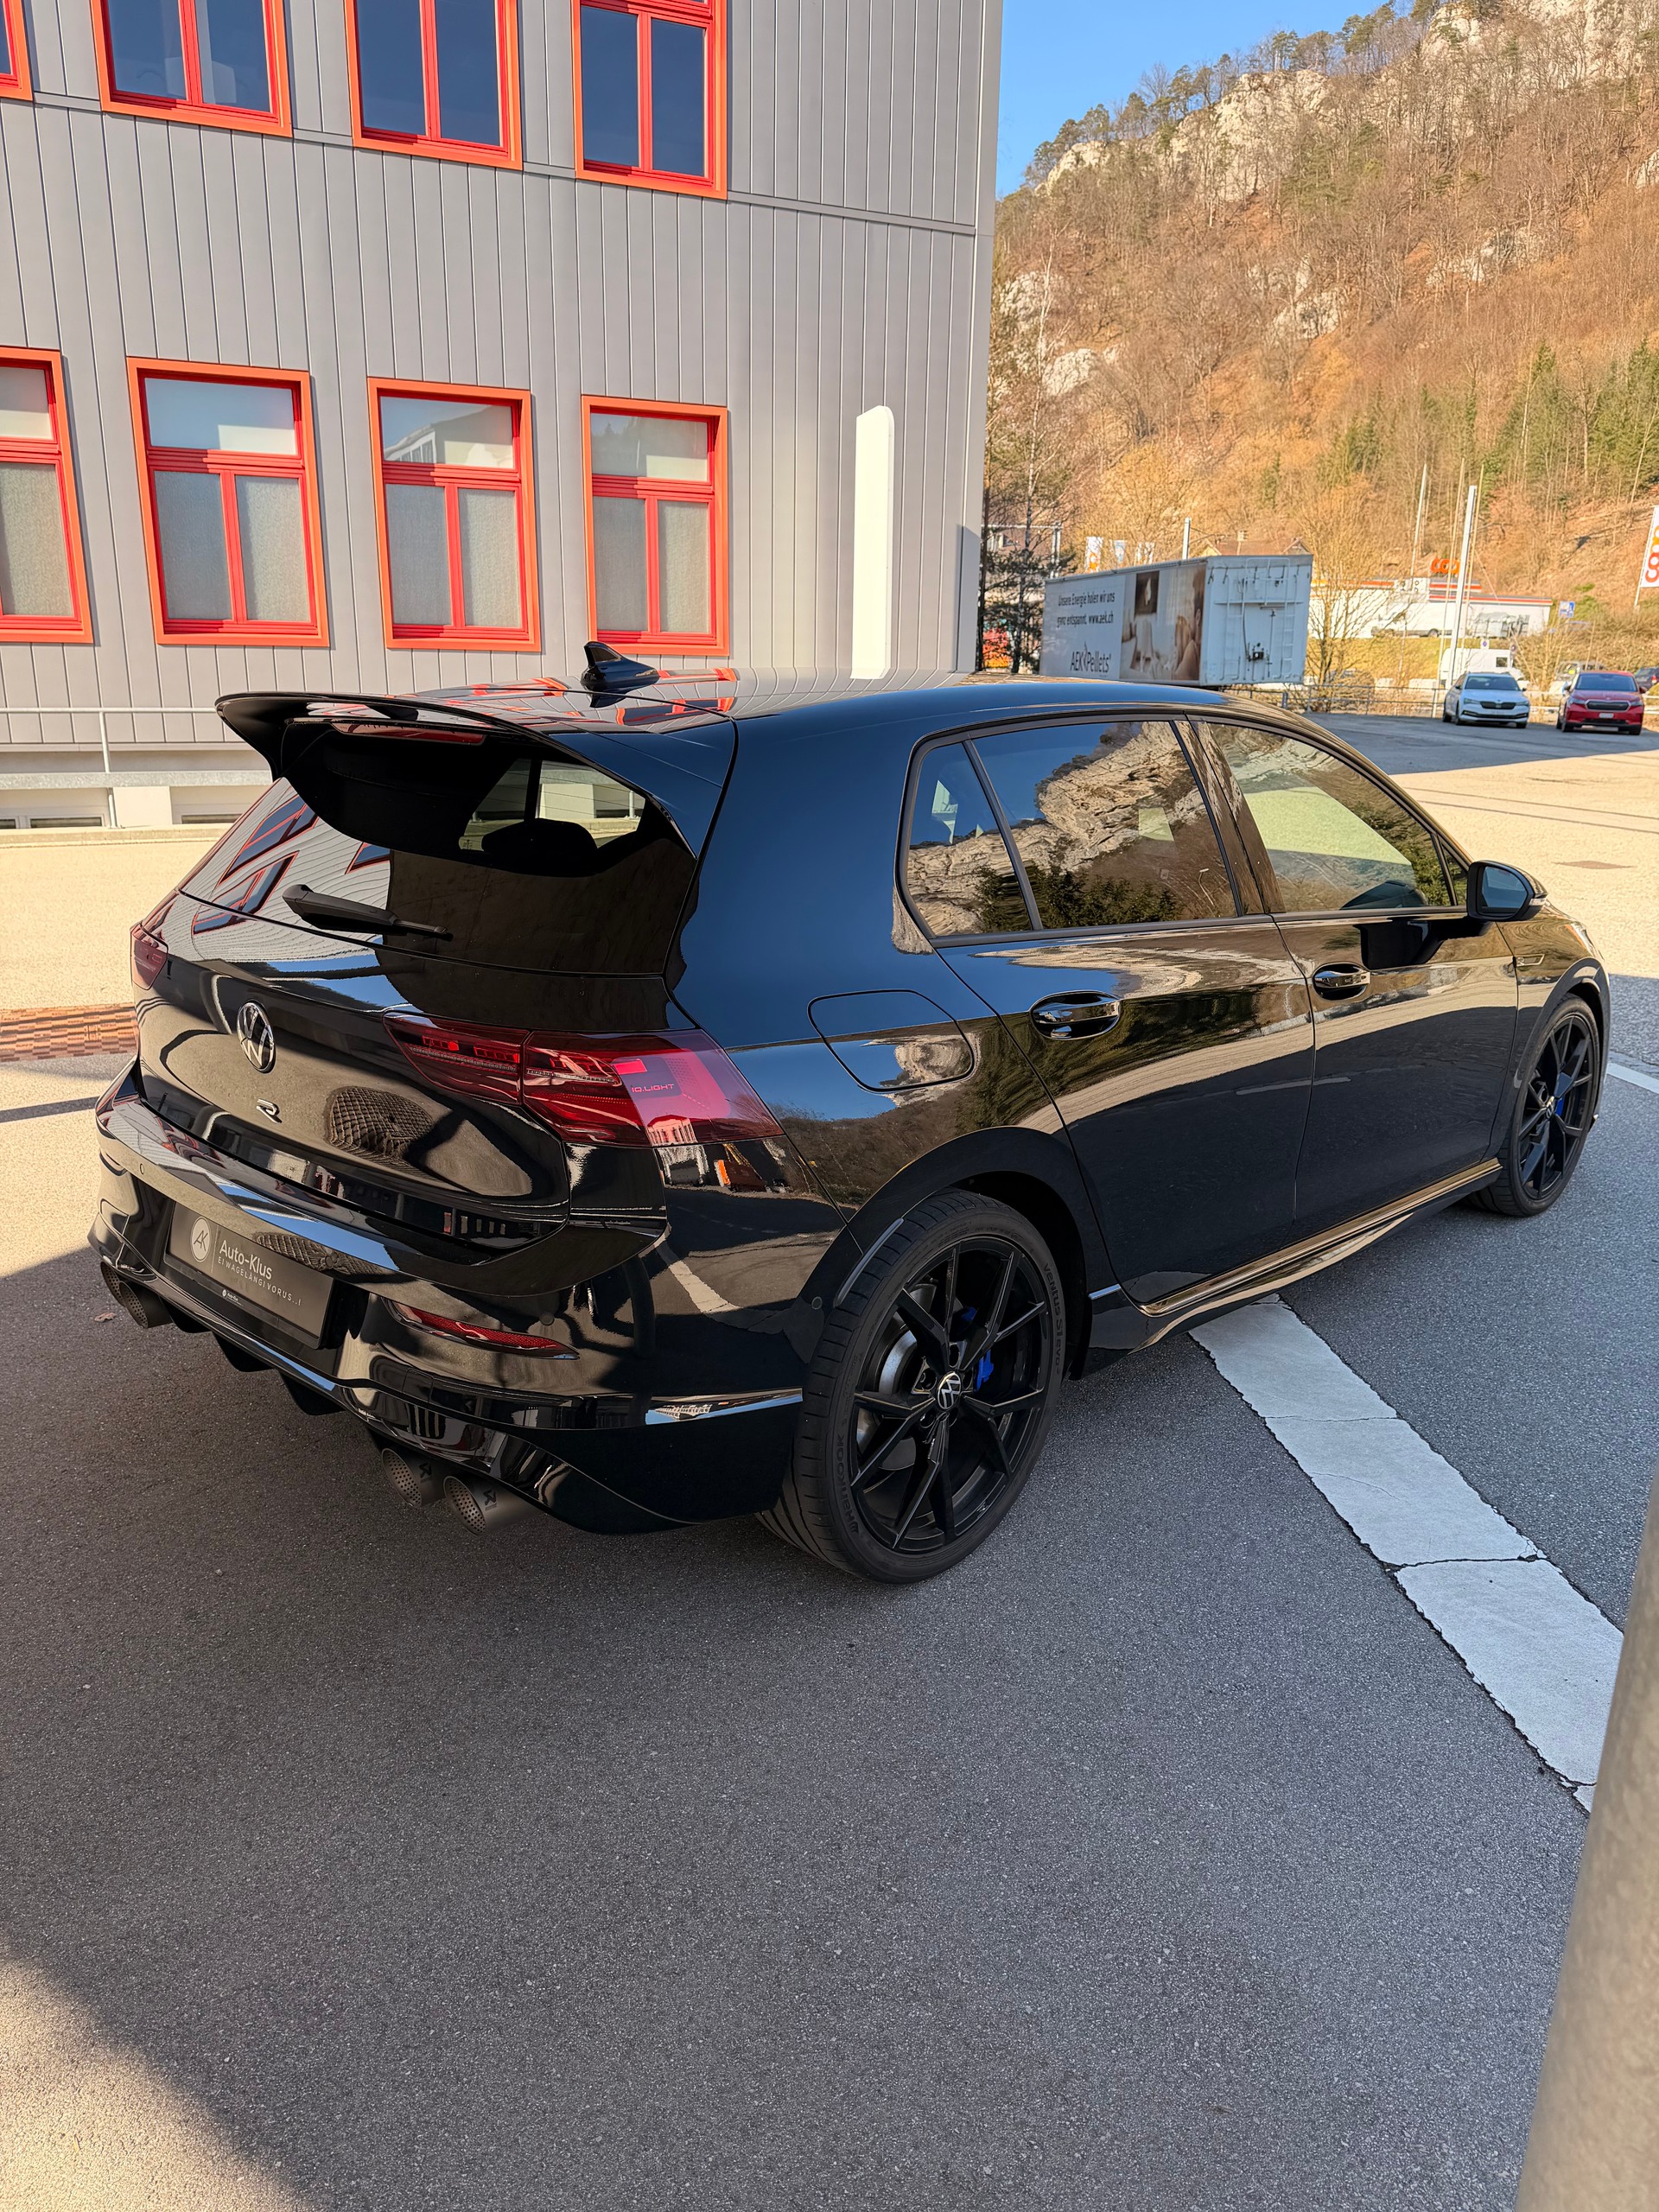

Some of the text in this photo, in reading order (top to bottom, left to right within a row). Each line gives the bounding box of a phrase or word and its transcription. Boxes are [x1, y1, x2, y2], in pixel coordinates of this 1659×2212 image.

[1071, 593, 1086, 607] Energie
[1089, 610, 1114, 624] www.aek.ch
[1070, 651, 1084, 671] AEK
[631, 1084, 674, 1093] IQ.LIGHT
[219, 1240, 272, 1280] Auto-Klus
